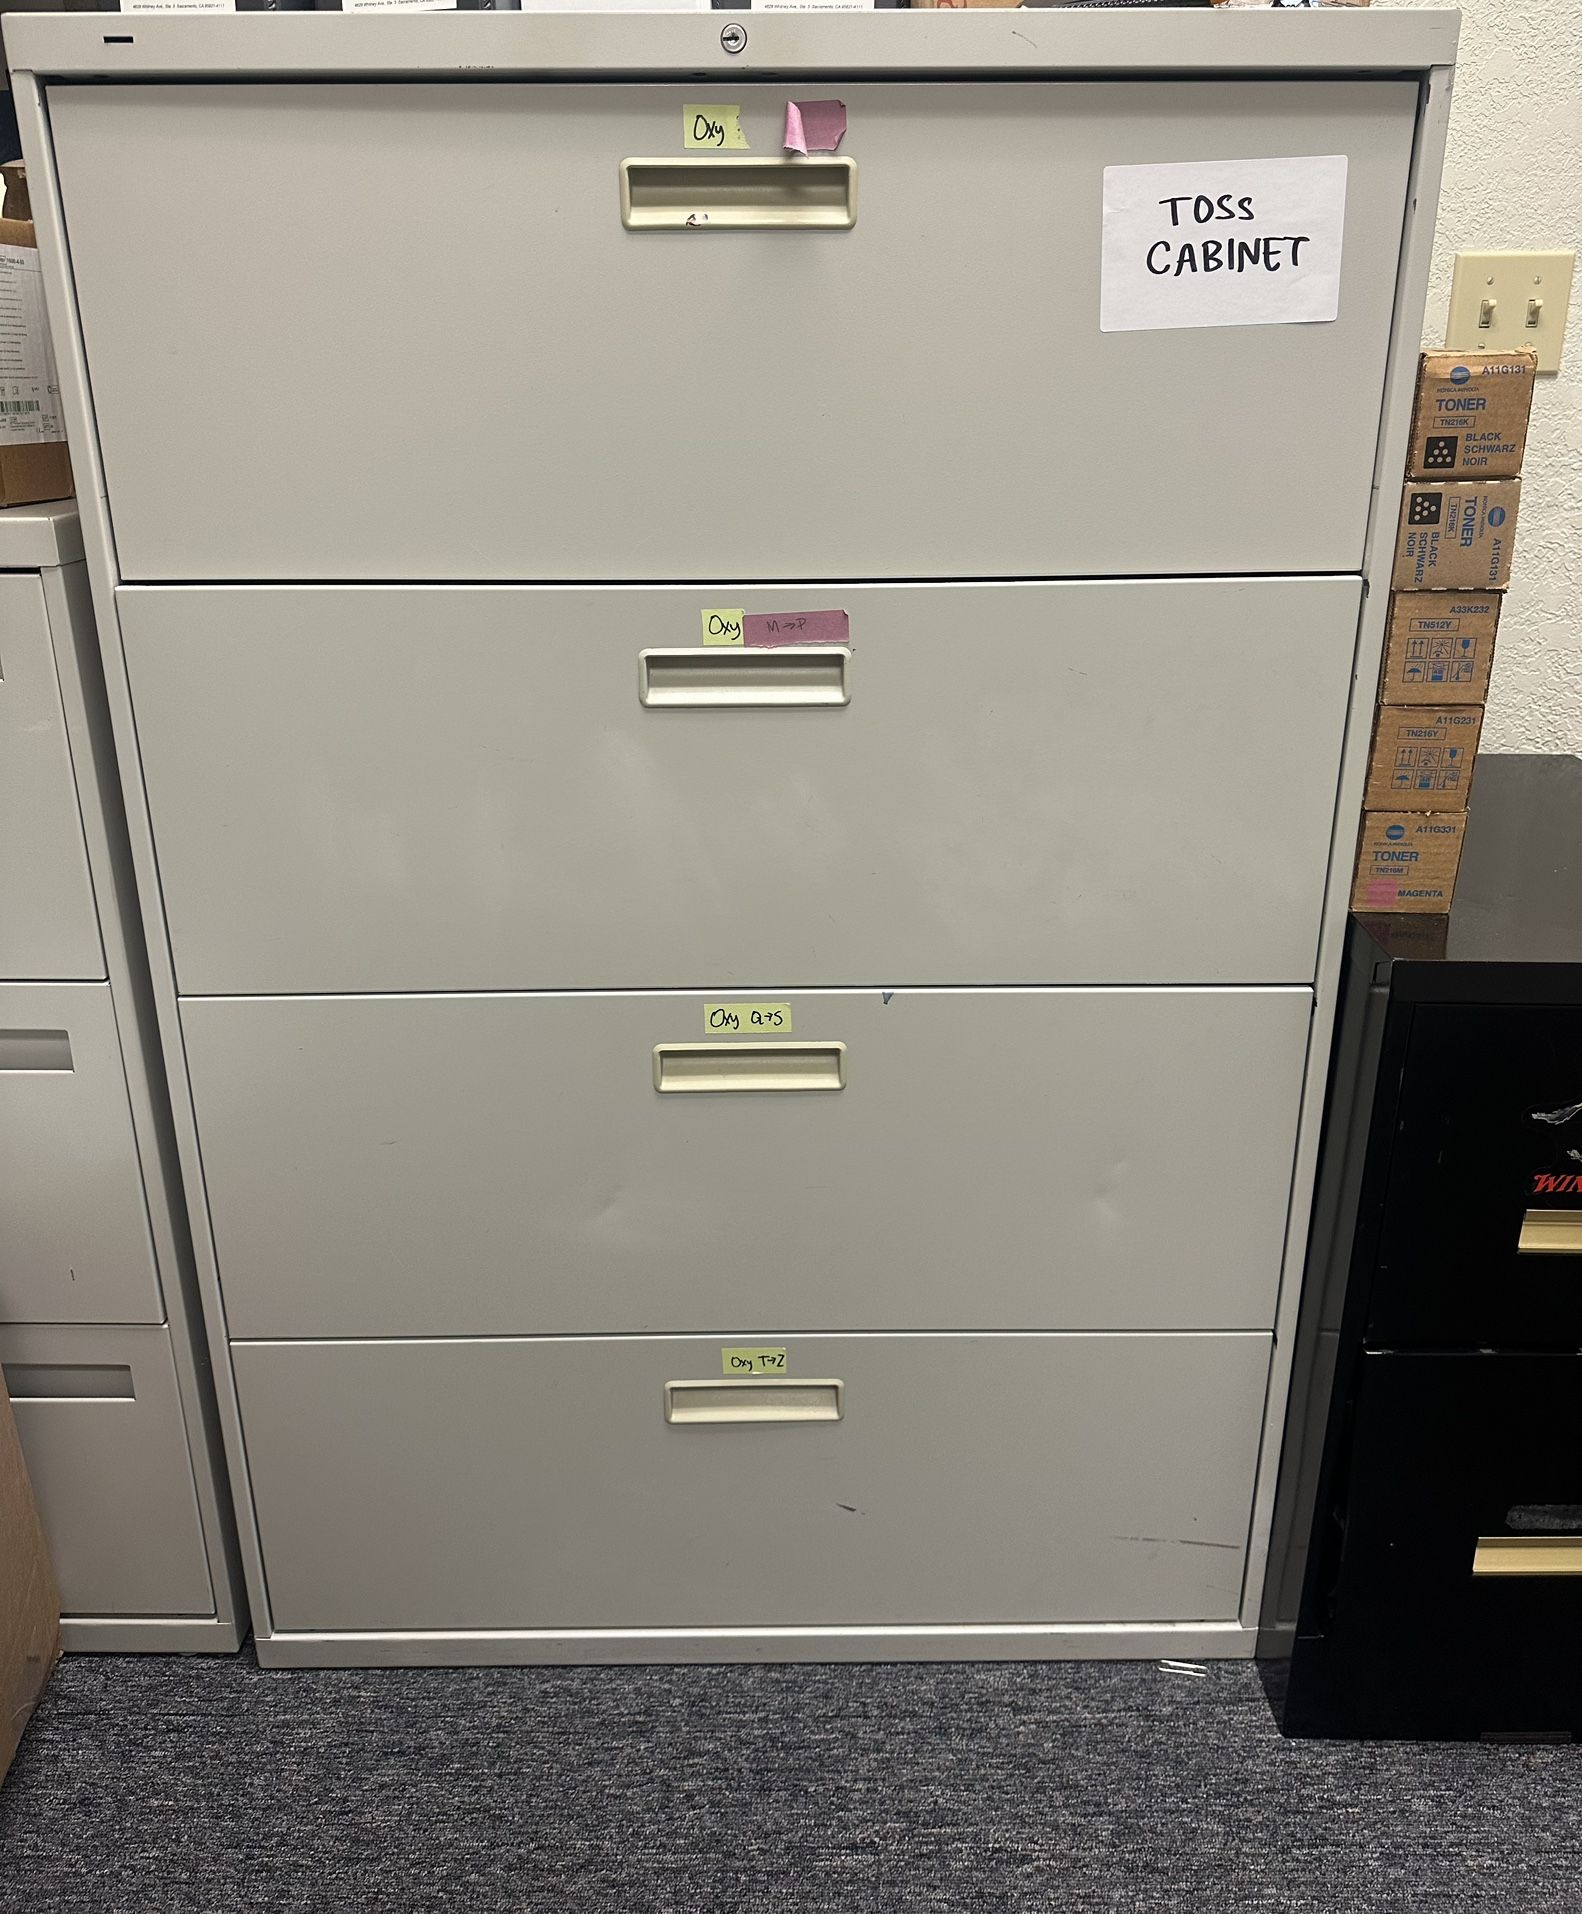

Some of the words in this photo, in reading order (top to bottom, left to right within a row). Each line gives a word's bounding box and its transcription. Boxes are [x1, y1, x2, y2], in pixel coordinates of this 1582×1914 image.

[693, 114, 725, 147] Oxy
[1158, 194, 1255, 226] TOSS
[1146, 236, 1310, 277] CABINET
[1481, 365, 1526, 376] A11G131
[1436, 398, 1487, 412] TONER
[1439, 418, 1470, 427] TN216K
[1465, 432, 1502, 442] BLACK
[1464, 443, 1516, 455] SCHWARZ
[1462, 457, 1488, 466] NOIR
[1460, 495, 1478, 548] TONER
[1405, 532, 1417, 558] NOIR
[1427, 531, 1440, 568] BLACK
[1414, 532, 1428, 584] SCHWARZ
[1488, 537, 1502, 582] A11G131
[1449, 605, 1490, 614] A33K232
[708, 614, 741, 640] Oxy
[766, 621, 780, 633] M
[1418, 620, 1453, 629] TN512Y
[1435, 715, 1477, 725] A11G231
[1406, 729, 1439, 738] TN216Y
[1415, 825, 1457, 834] A11G331
[1372, 850, 1420, 862] TONER
[1397, 889, 1444, 898] MAGENTA
[710, 1008, 740, 1030] Oxy
[731, 1356, 753, 1372] Oxy
